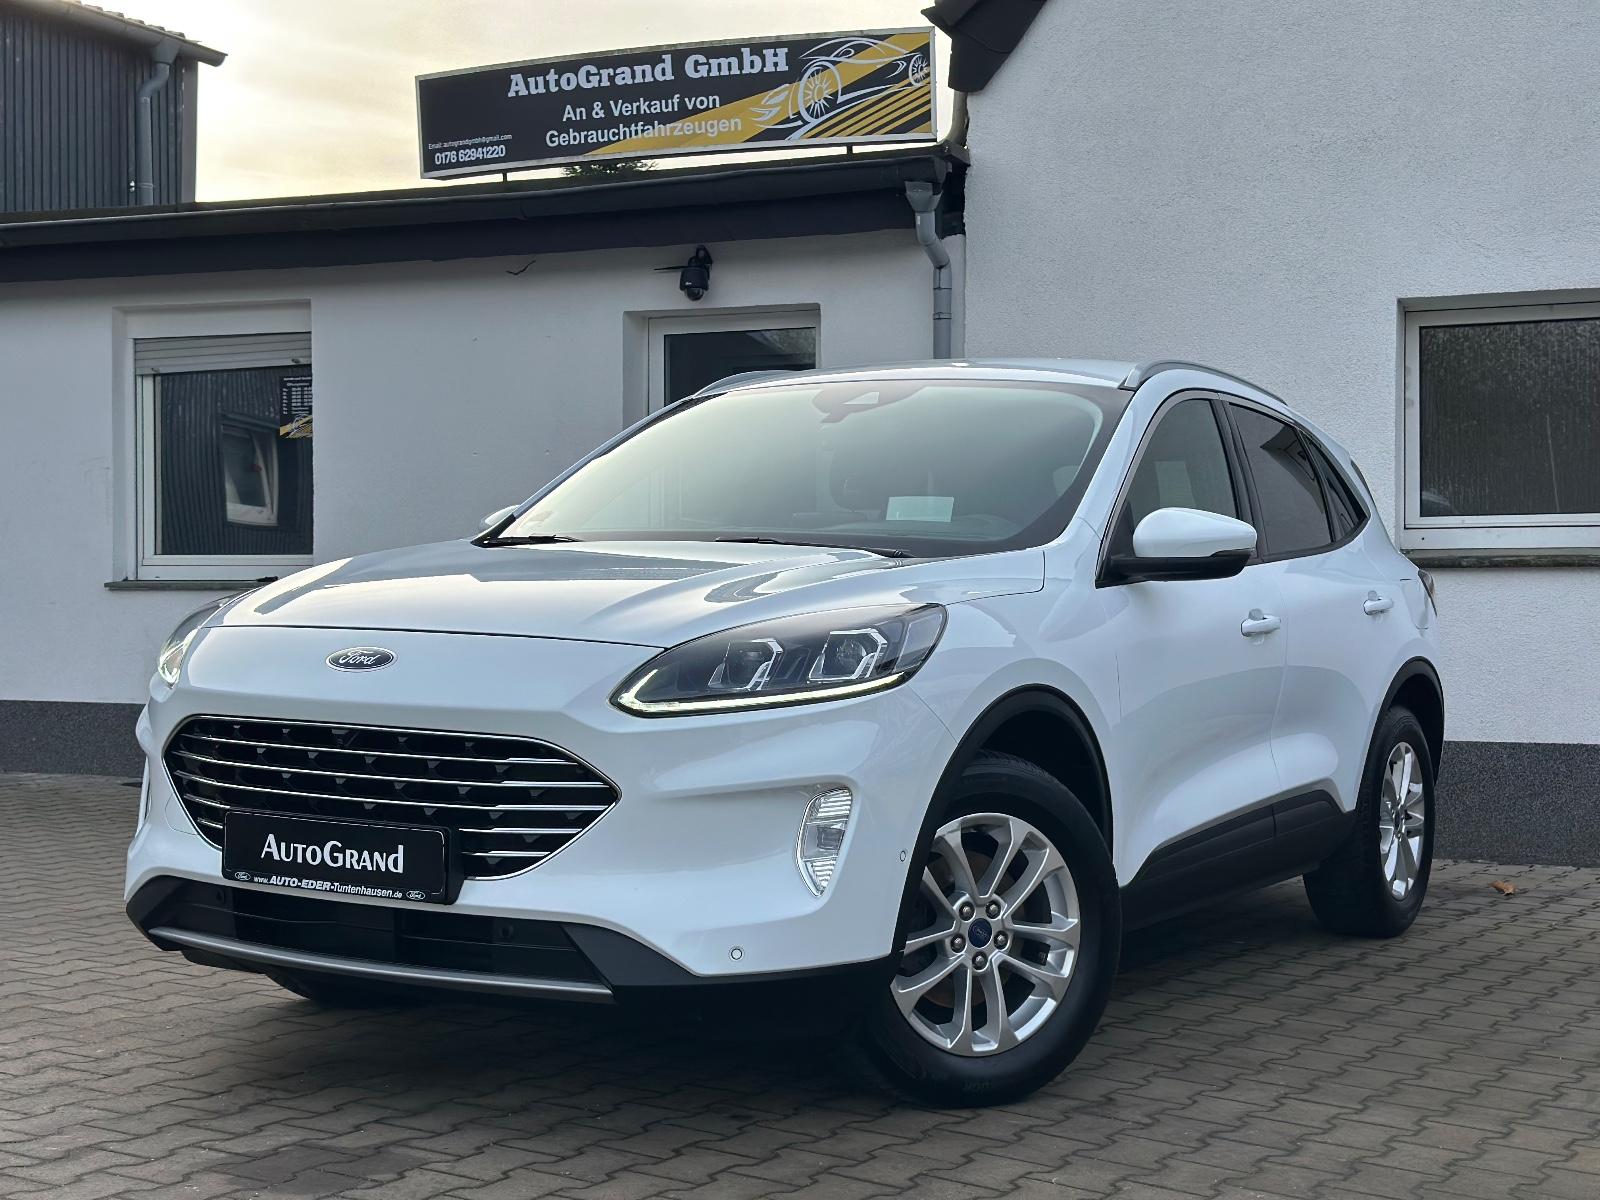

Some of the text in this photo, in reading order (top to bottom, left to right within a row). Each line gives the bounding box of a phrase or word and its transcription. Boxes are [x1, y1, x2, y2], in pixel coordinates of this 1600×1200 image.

[507, 47, 789, 98] AutoGrand GmbH
[562, 94, 720, 122] An & Verkauf von
[545, 117, 742, 147] Gebrauchtfahrzeugen
[434, 144, 506, 165] 0176 62941220
